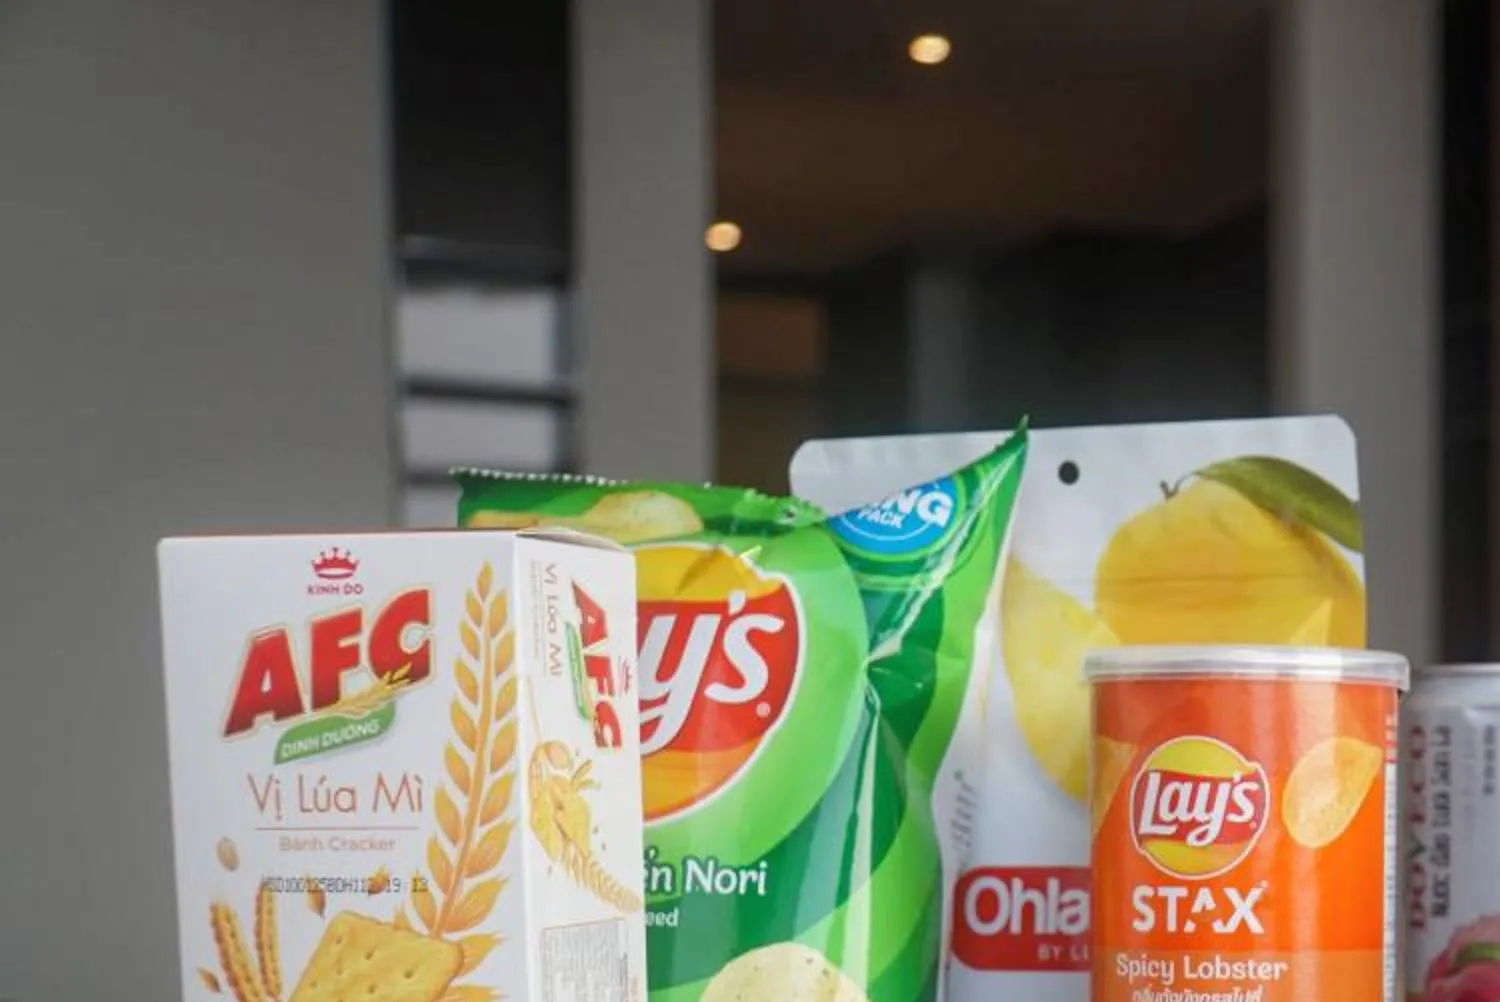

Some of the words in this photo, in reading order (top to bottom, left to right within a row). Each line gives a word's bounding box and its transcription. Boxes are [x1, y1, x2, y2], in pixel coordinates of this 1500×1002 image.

[222, 588, 432, 738] AFC
[571, 580, 622, 749] AFC
[638, 589, 784, 756] y's
[247, 774, 283, 822] Vị
[298, 772, 356, 814] Lúa
[373, 774, 422, 813] Mì
[1140, 771, 1260, 847] Lay's
[329, 836, 396, 851] Cracker
[685, 858, 768, 895] Nori
[1131, 885, 1265, 934] STAX
[1037, 946, 1061, 961] BY
[1116, 953, 1176, 986] Spicy
[1184, 953, 1289, 981] Lobster
